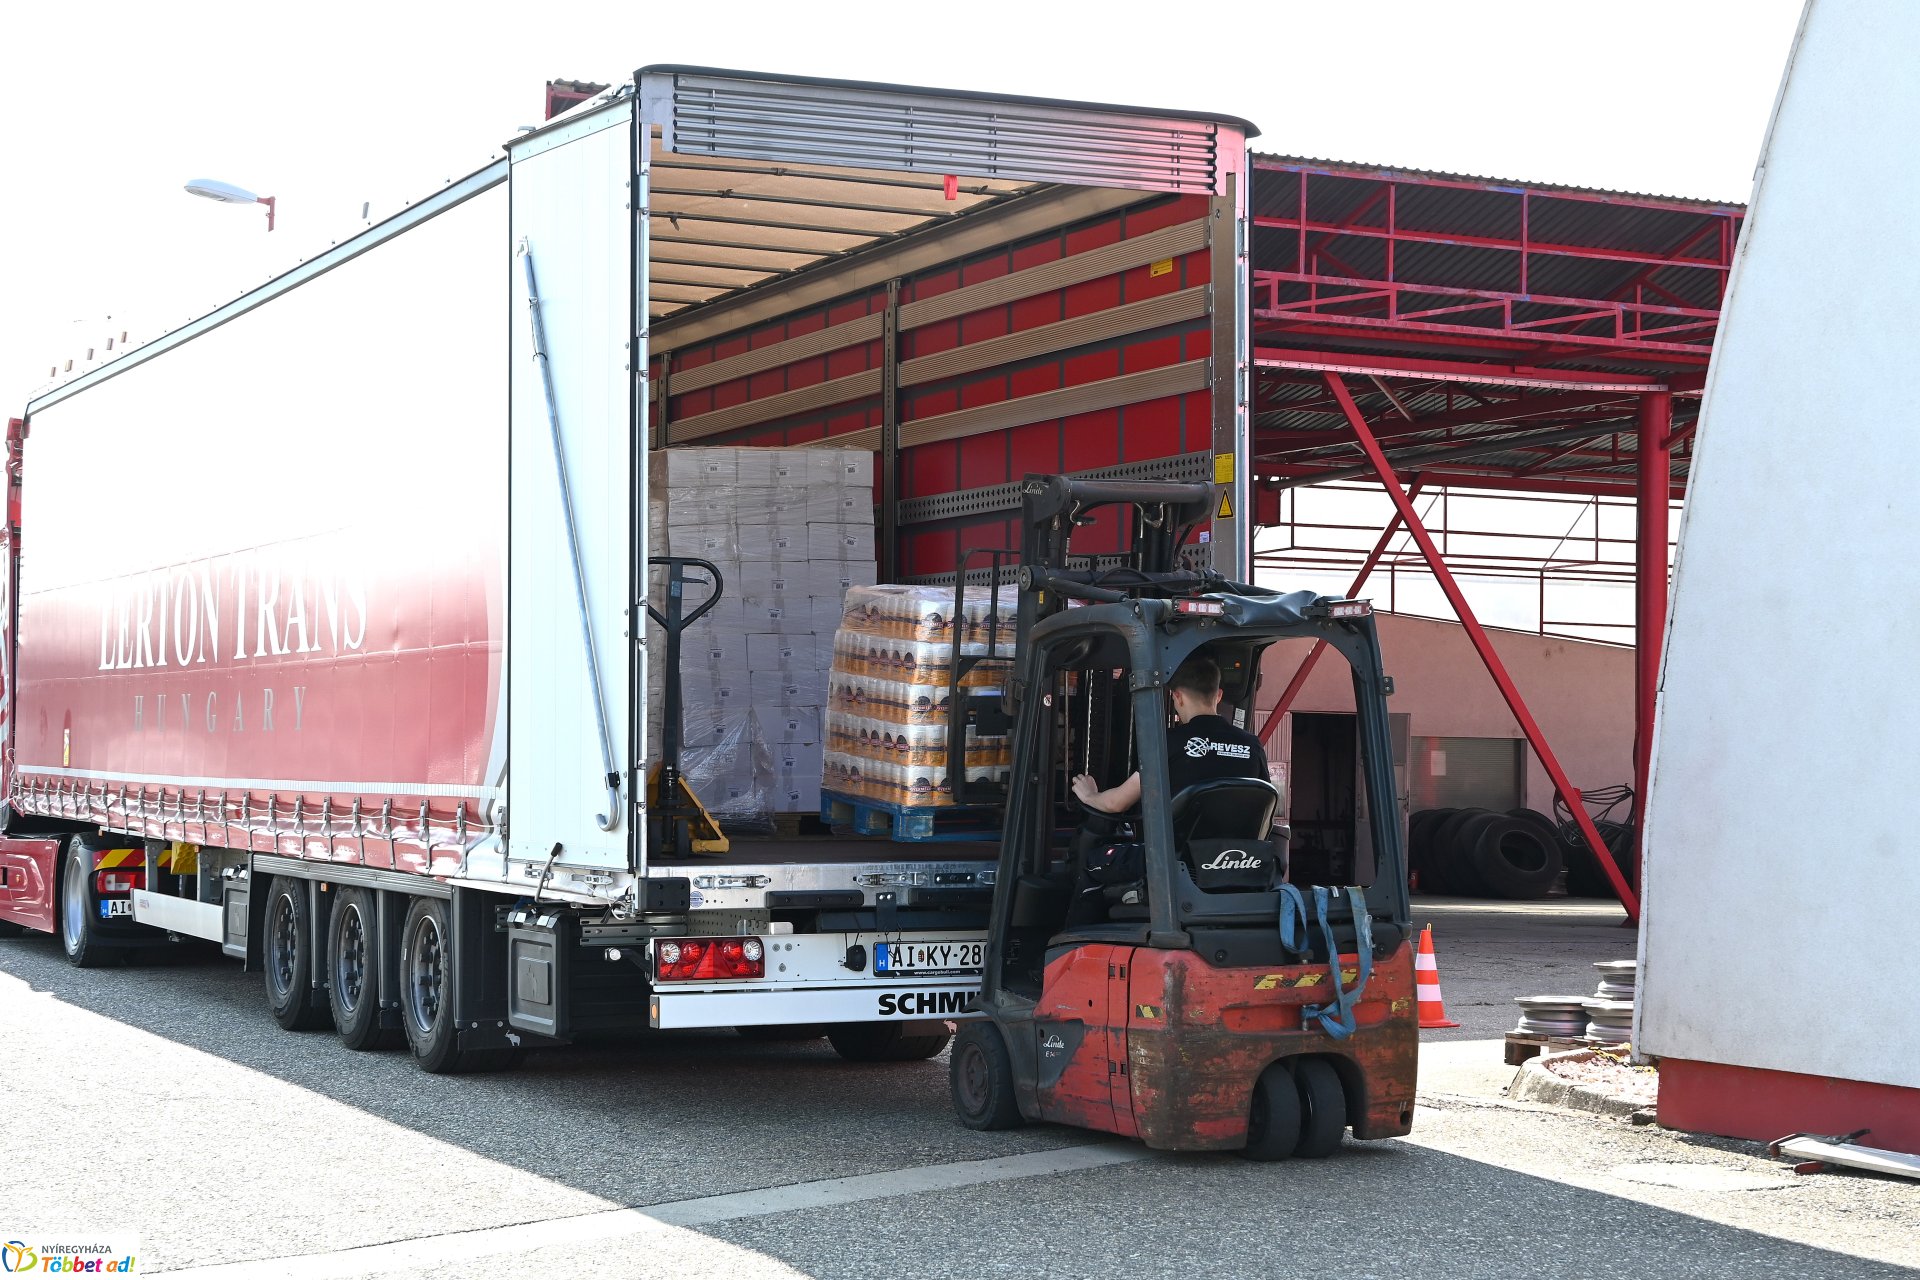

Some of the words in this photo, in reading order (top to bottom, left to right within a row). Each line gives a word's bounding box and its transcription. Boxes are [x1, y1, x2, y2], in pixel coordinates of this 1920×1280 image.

[98, 564, 220, 670] LERTON
[227, 556, 367, 660] TRANS
[134, 686, 307, 733] HUNGARY
[1210, 742, 1251, 754] REVESZ
[1201, 849, 1262, 870] Linde
[878, 959, 886, 968] H
[1042, 1034, 1065, 1049] Linde
